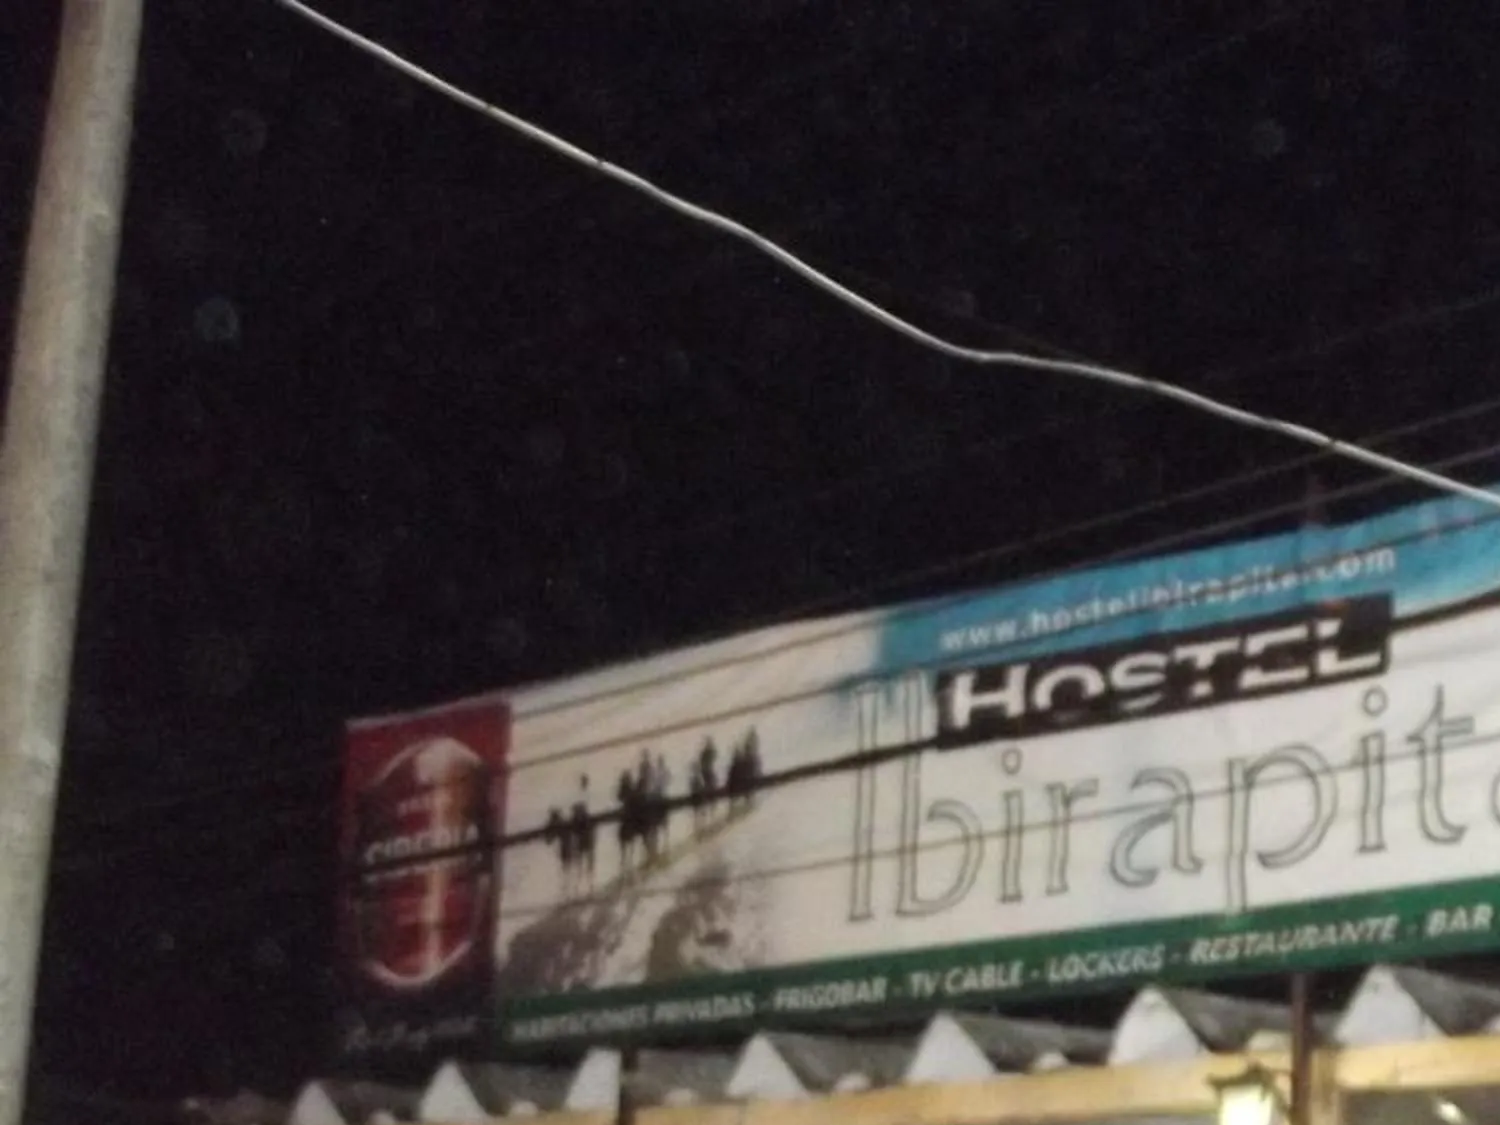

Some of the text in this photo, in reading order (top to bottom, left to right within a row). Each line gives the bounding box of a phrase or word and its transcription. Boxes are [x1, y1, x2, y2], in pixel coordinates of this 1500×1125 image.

[950, 618, 1384, 731] HOSTEL
[909, 971, 943, 998] TV
[943, 960, 1025, 994] CABLE
[1046, 943, 1166, 983] LOCKERS
[1189, 914, 1400, 965] RESTAURANTE
[1424, 902, 1496, 937] BAR
